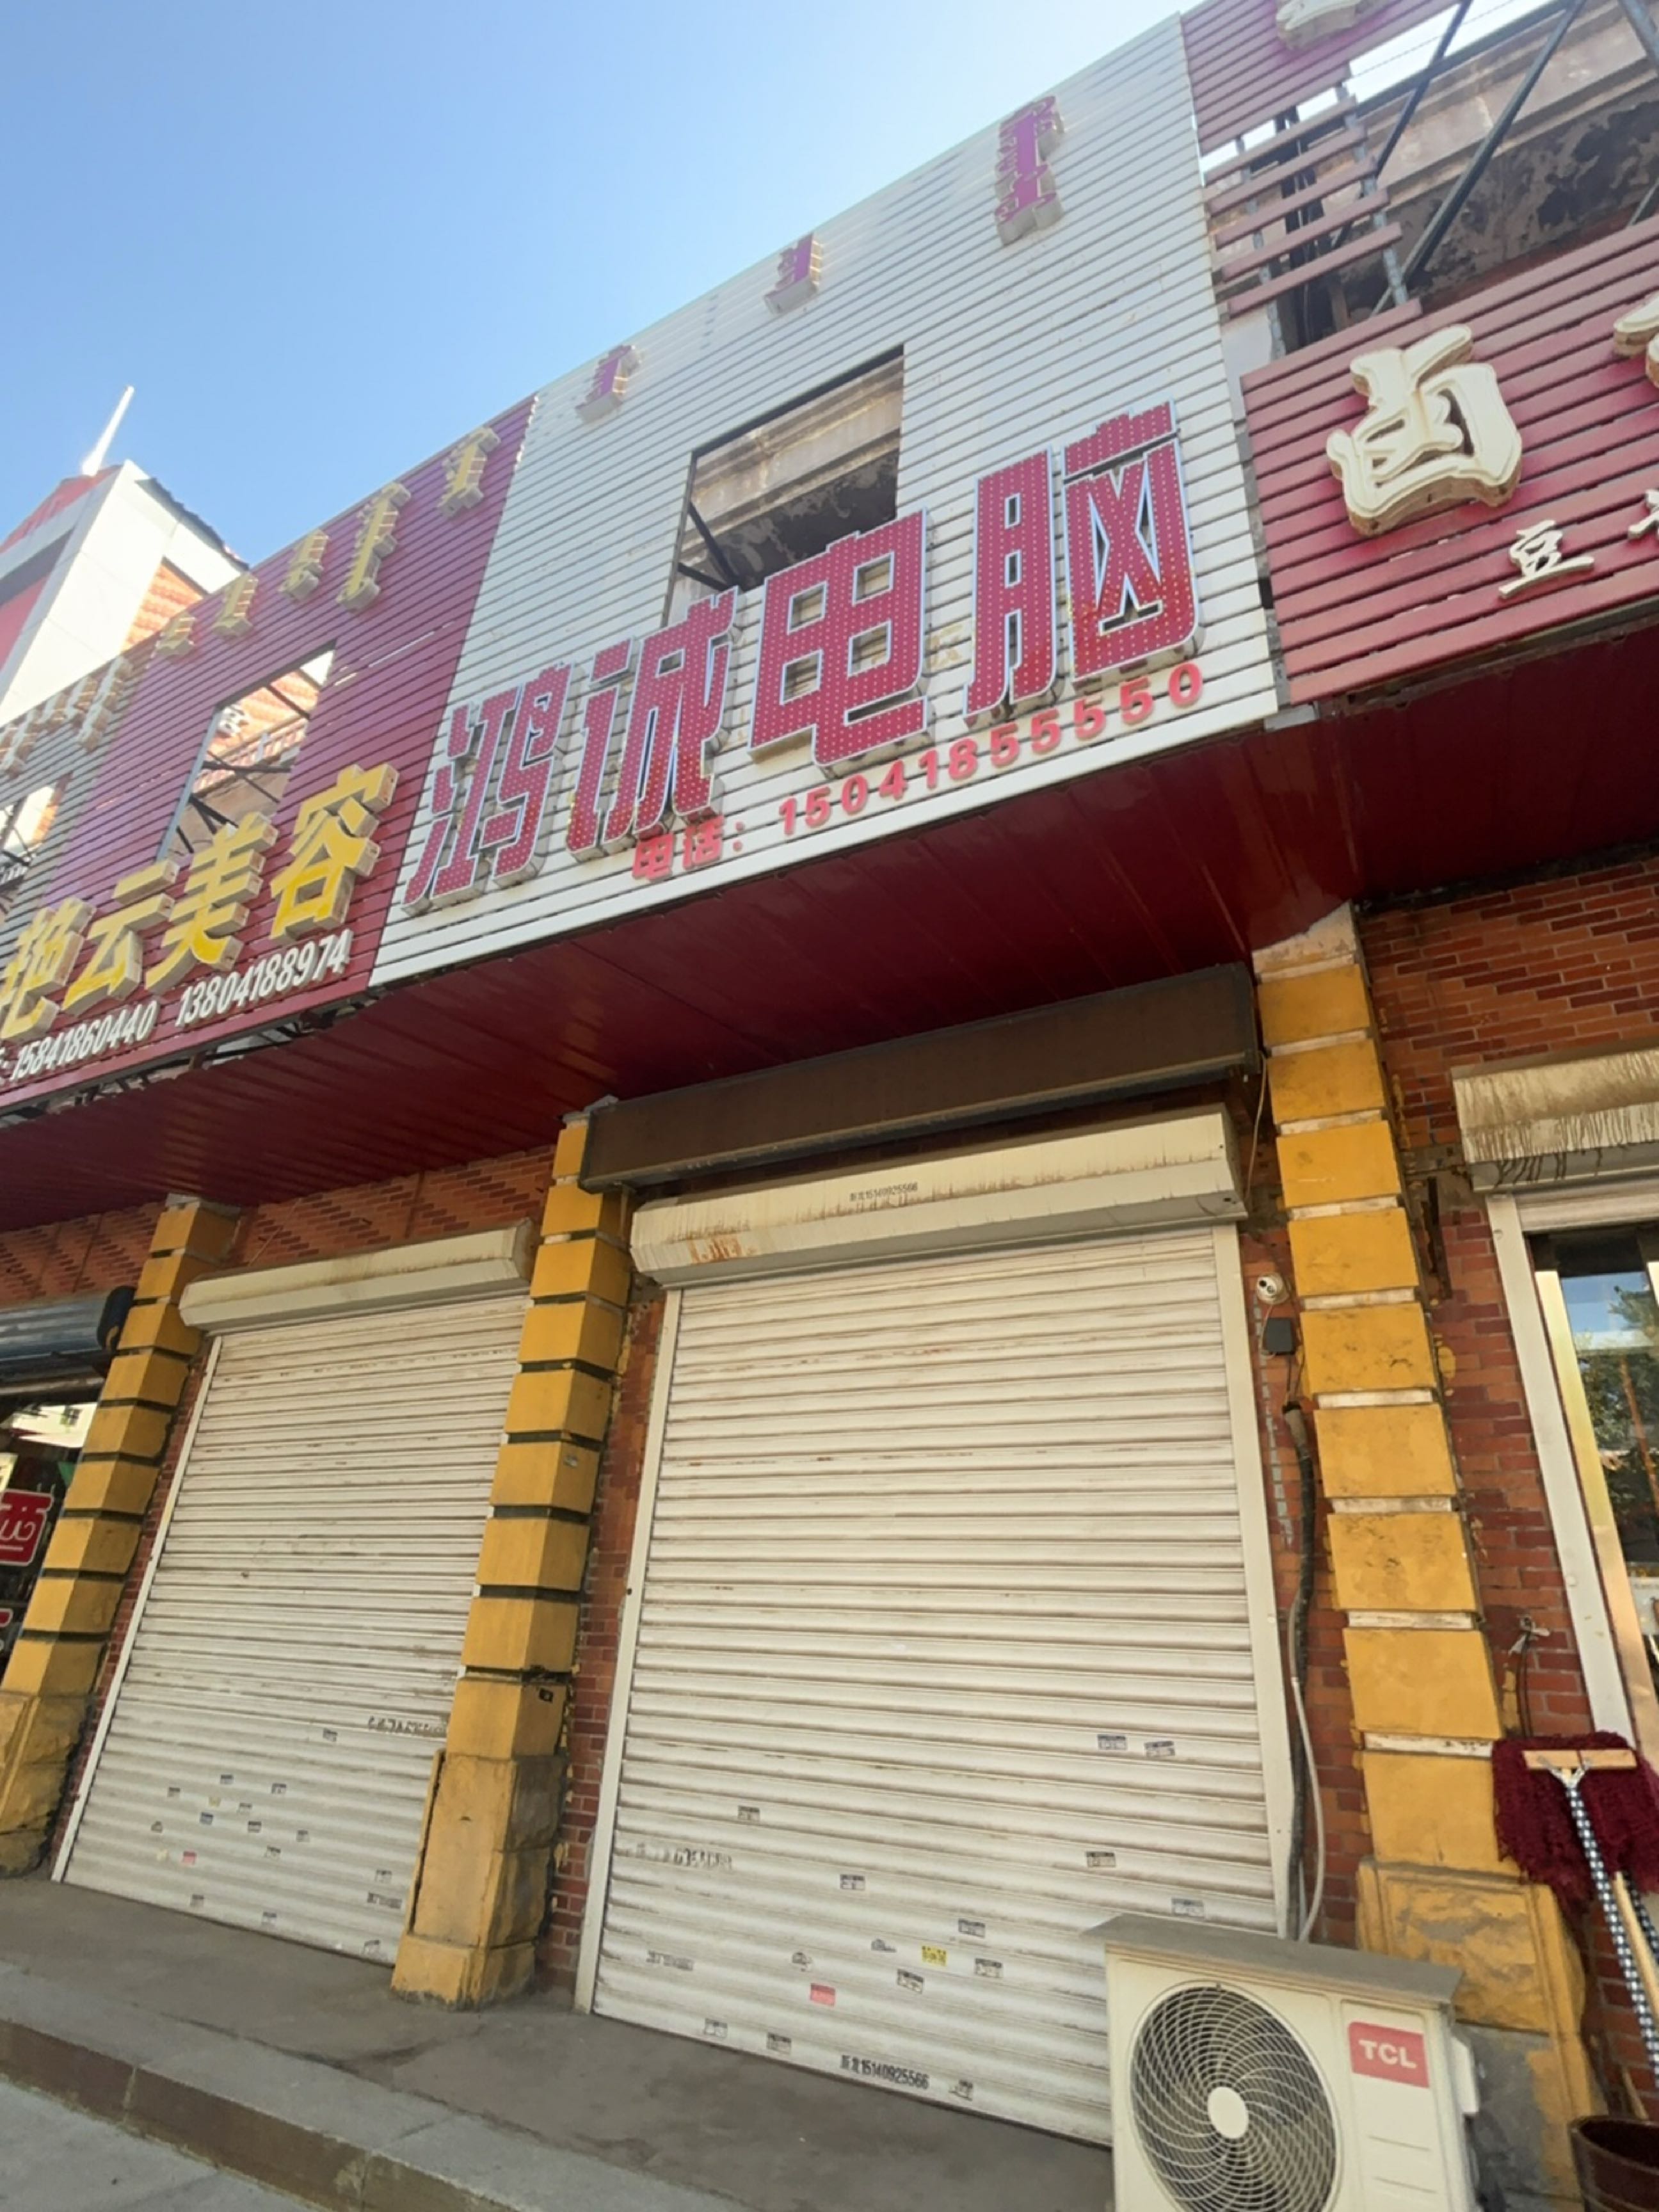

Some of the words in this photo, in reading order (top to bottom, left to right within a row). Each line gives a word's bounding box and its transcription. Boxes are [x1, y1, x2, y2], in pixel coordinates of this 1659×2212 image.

[403, 401, 1202, 911] 鸿诚电脑
[778, 662, 1204, 837] 15041855550
[0, 764, 399, 1042] 艳云美容
[9, 1000, 158, 1083] 15841860440
[175, 928, 353, 1028] 13804188974
[1358, 2039, 1418, 2069] TCL
